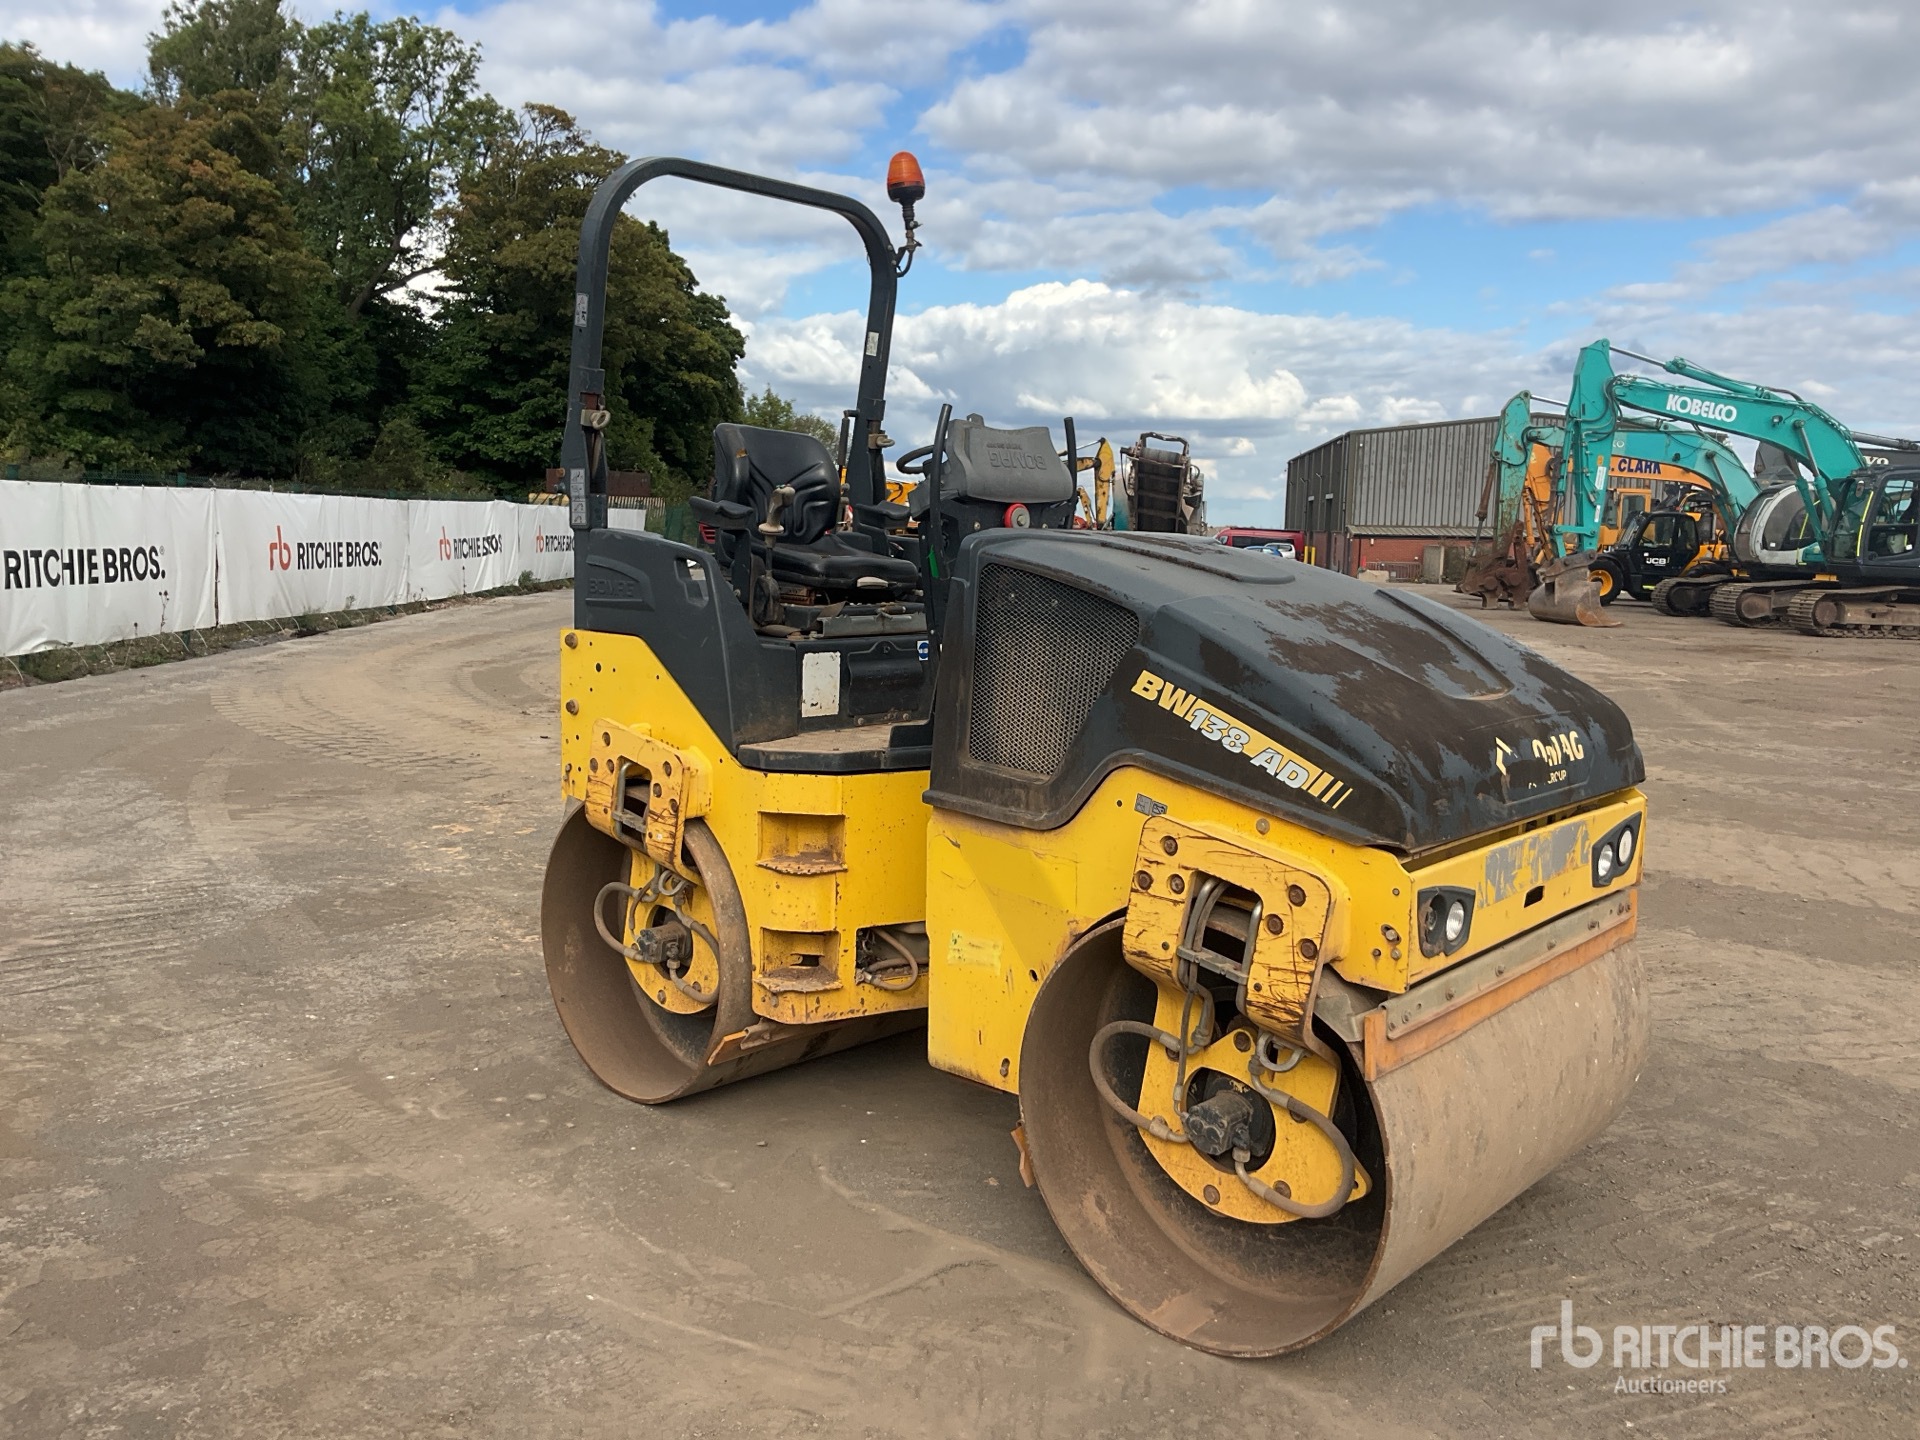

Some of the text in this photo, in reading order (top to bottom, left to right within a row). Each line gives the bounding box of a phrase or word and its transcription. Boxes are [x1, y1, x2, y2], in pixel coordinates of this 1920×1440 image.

[1666, 393, 1737, 422] KOBELCO
[3, 545, 166, 590] RITCHIE BROS.
[297, 541, 343, 570] RITCHIE
[346, 541, 382, 567] BROS.
[1646, 557, 1666, 565] JCB
